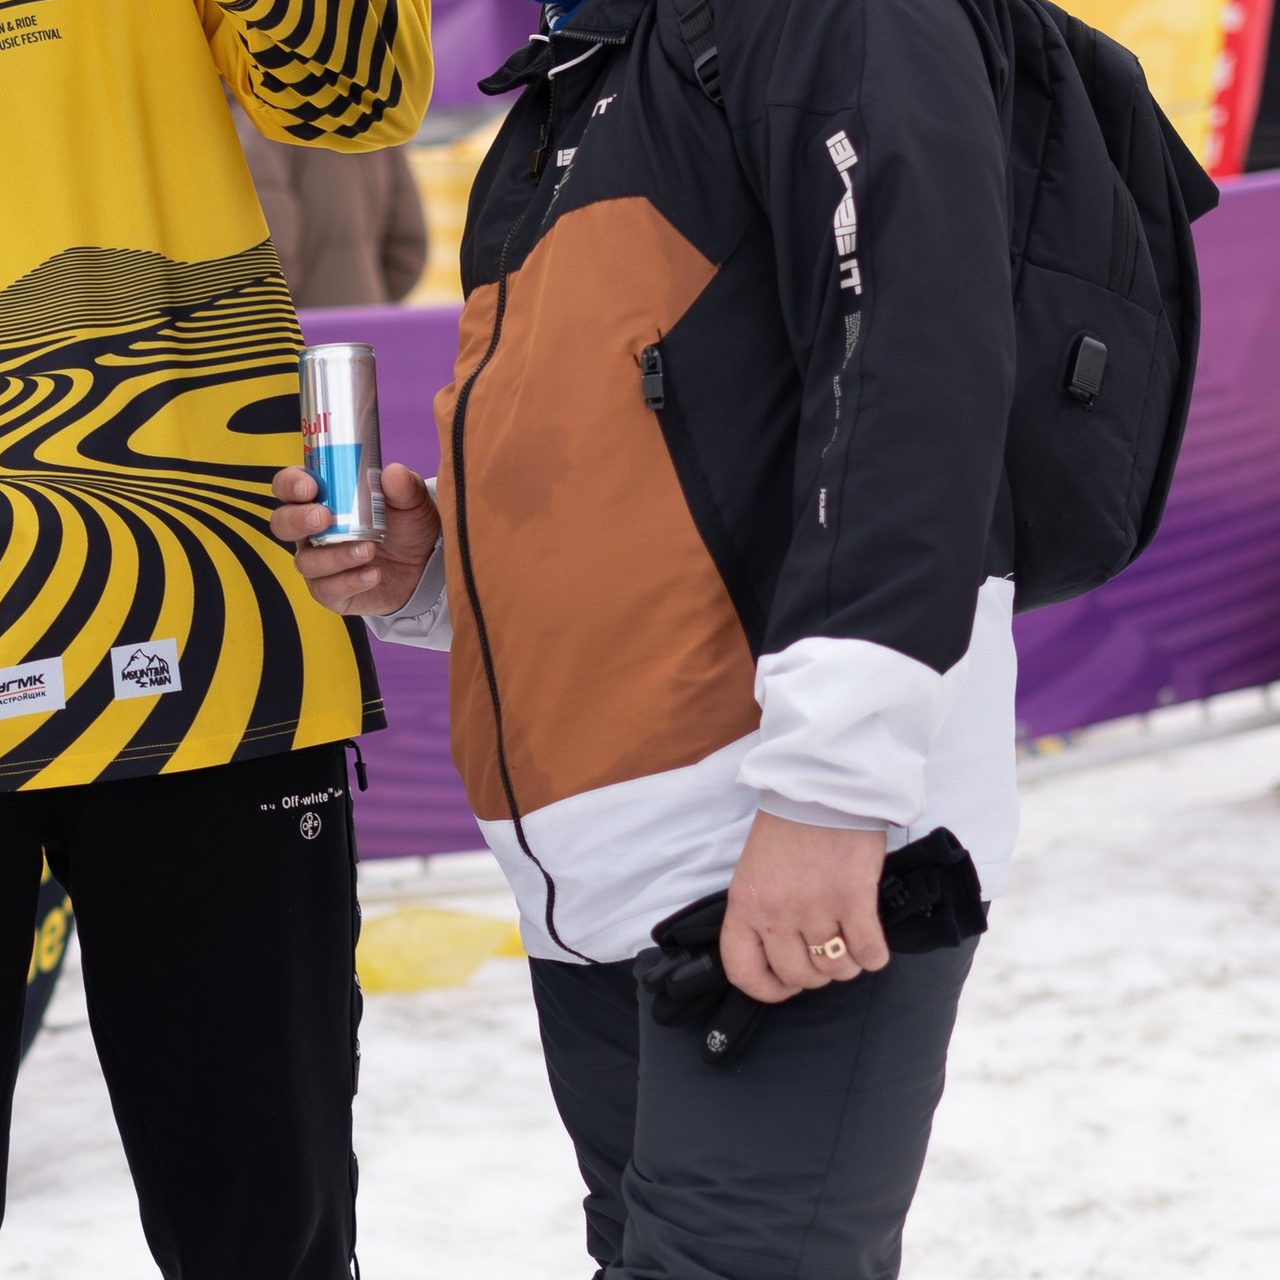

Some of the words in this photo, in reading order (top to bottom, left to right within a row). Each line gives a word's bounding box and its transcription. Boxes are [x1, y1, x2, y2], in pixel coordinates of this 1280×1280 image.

[7, 21, 15, 32] &
[15, 15, 38, 30] RIDE
[20, 28, 62, 45] FESTIVAL
[122, 666, 170, 682] MOUNTAIN
[149, 674, 172, 687] MAN
